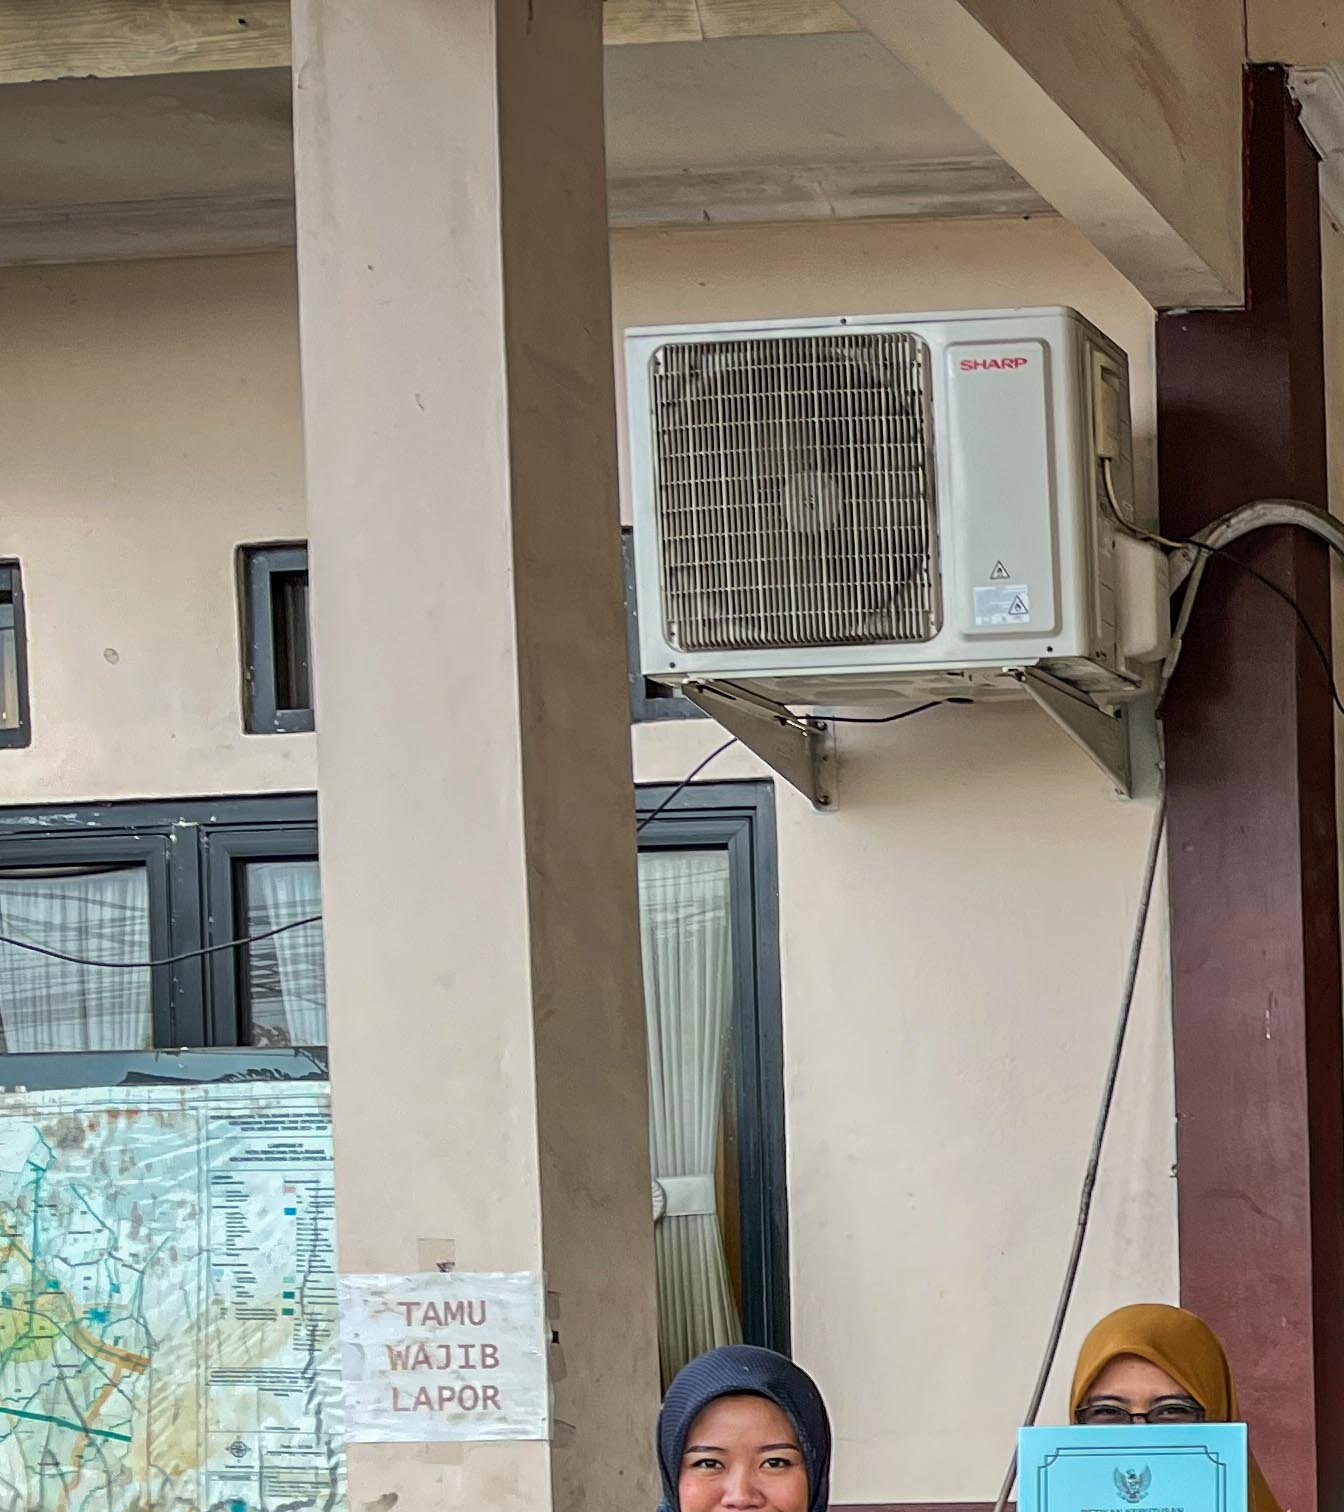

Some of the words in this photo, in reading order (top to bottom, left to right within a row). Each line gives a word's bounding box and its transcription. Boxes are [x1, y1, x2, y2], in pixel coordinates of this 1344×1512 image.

[960, 358, 1027, 370] SHARP
[397, 1300, 486, 1326] TAMU
[385, 1342, 500, 1371] WAJIB
[392, 1385, 502, 1412] LAPOR
